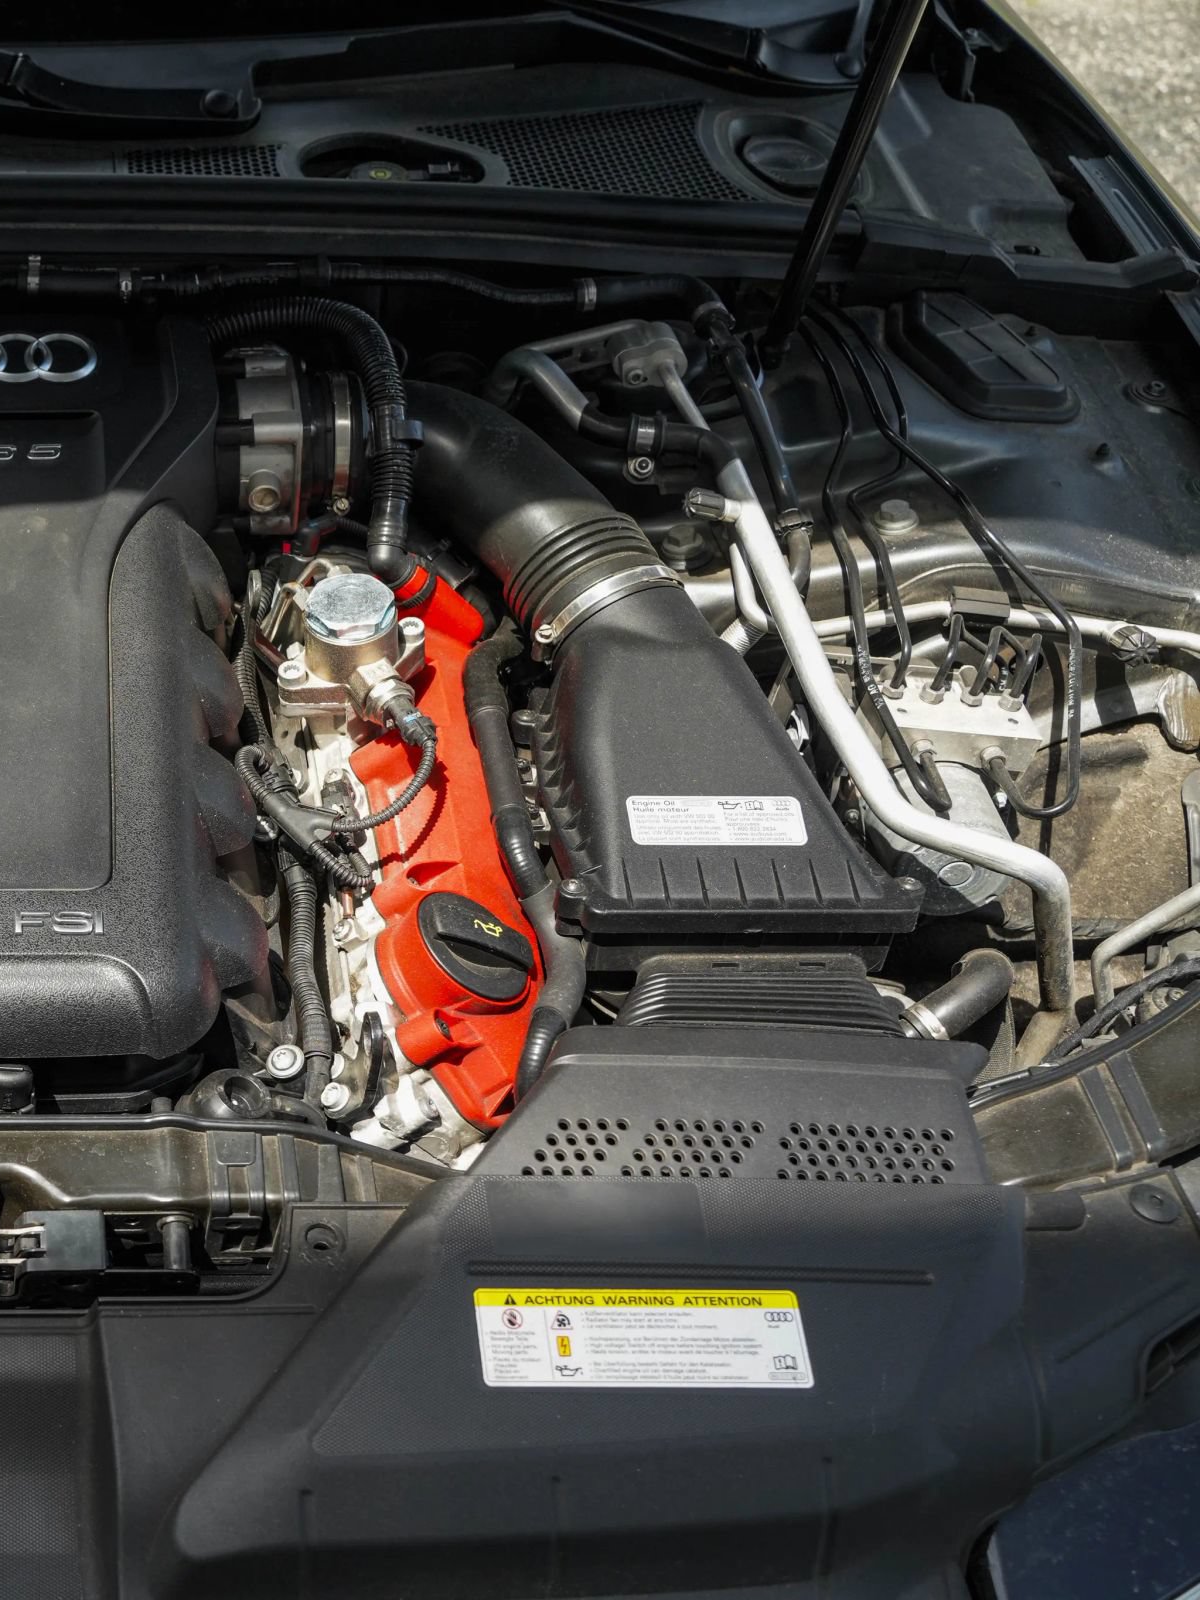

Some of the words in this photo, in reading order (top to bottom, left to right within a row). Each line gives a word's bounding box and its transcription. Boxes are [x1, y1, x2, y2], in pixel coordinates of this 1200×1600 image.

[26, 444, 62, 460] 5
[14, 910, 104, 935] FSI
[524, 1295, 594, 1306] ACHTUNG
[602, 1295, 675, 1306] WARNING
[683, 1296, 763, 1306] ATTENTION
